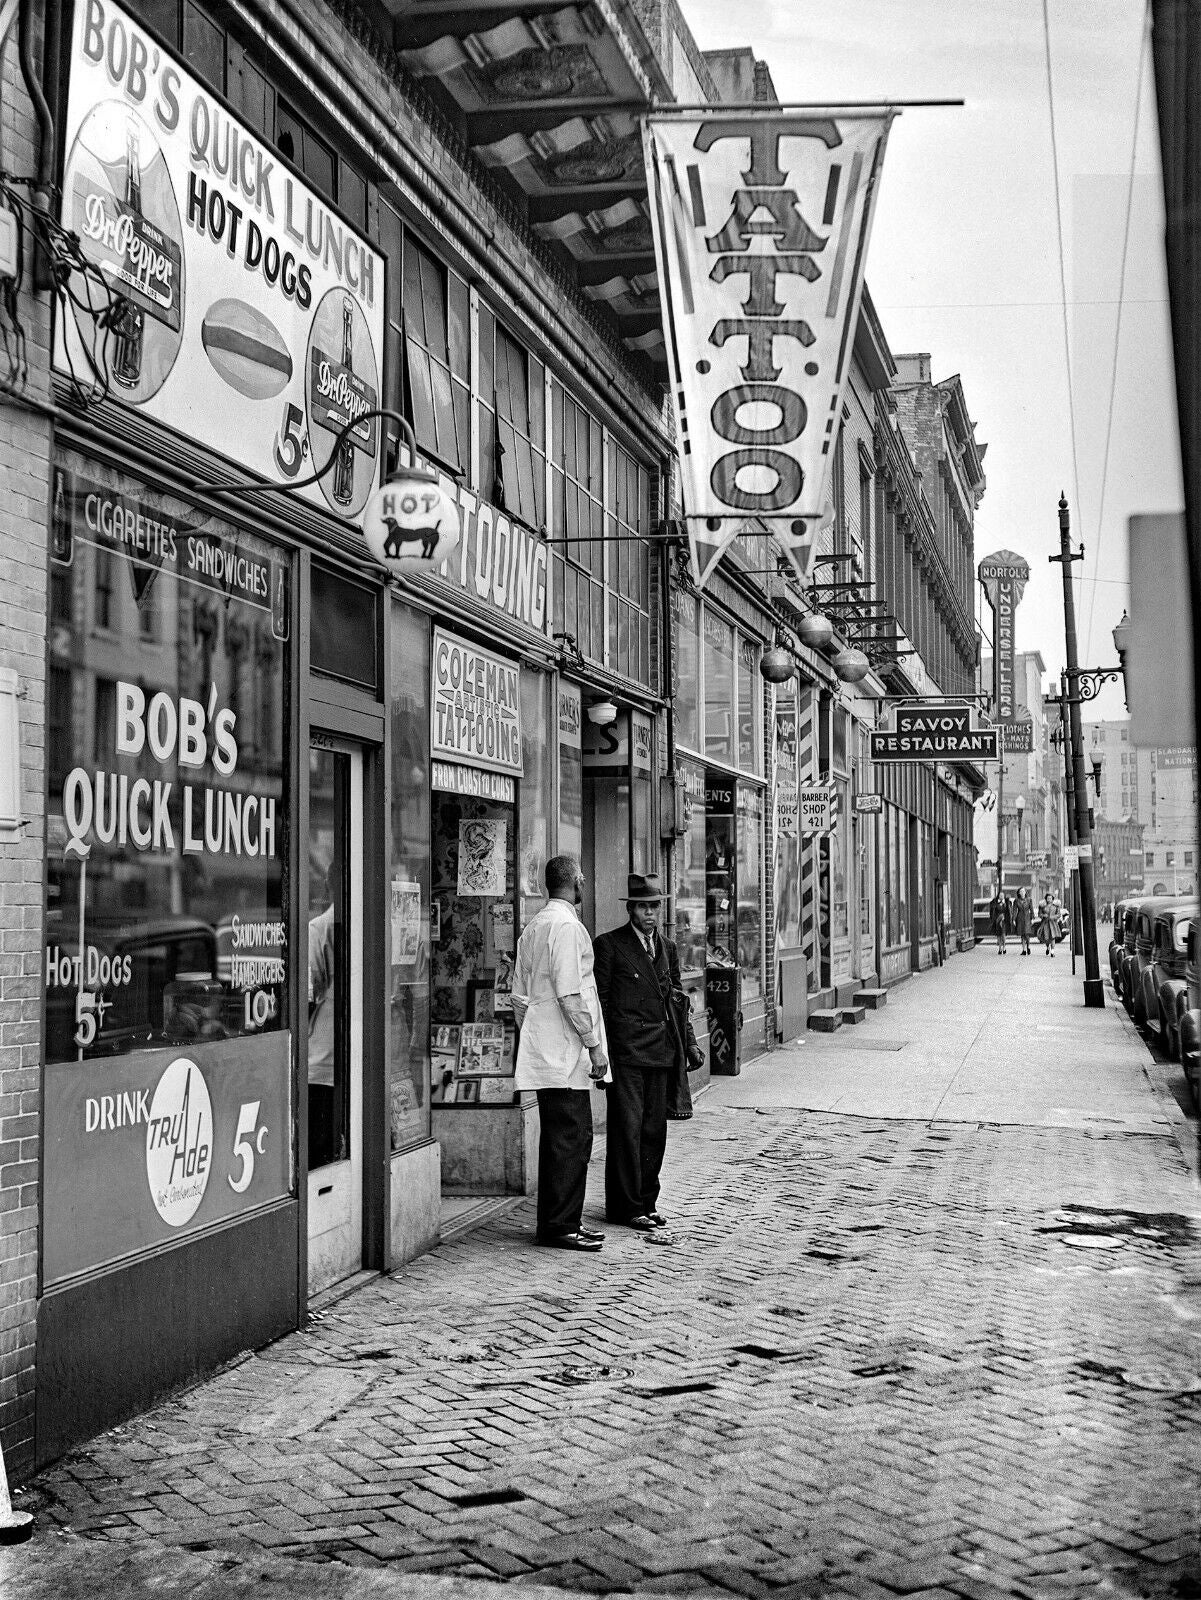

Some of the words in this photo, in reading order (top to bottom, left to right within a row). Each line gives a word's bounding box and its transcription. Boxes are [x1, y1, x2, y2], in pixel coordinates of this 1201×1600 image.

[81, 0, 182, 135] BOB'S
[189, 95, 276, 221] QUICK
[284, 177, 376, 308] LUNCH
[186, 171, 243, 256] HOT
[245, 224, 314, 311] DOGS
[693, 119, 843, 511] TATTOO
[383, 494, 437, 516] HOT
[84, 493, 177, 562] CIGARETTES
[187, 535, 268, 598] SANDWICHES
[983, 567, 1028, 579] NORFOLK
[1000, 583, 1012, 717] UNDERSELLERS
[437, 642, 518, 710] COLEMAN
[454, 690, 500, 721] ARTISTIC
[901, 718, 967, 732] SAVOY
[115, 680, 239, 777] BOB'S
[436, 701, 520, 765] TATTOOING
[875, 736, 994, 751] RESTAURANT
[432, 762, 456, 790] FROM
[457, 765, 482, 795] COAST
[491, 775, 515, 801] COAST
[802, 793, 829, 802] BARBER
[63, 766, 176, 859] QUICK
[182, 785, 277, 860] LUNCH
[803, 804, 826, 815] SHOP
[808, 816, 823, 827] 421
[46, 946, 81, 986] HOT
[87, 946, 132, 987] DOGS
[231, 954, 286, 989] HAMBURGERS
[707, 980, 730, 993] 423
[86, 1088, 150, 1132] DRINK
